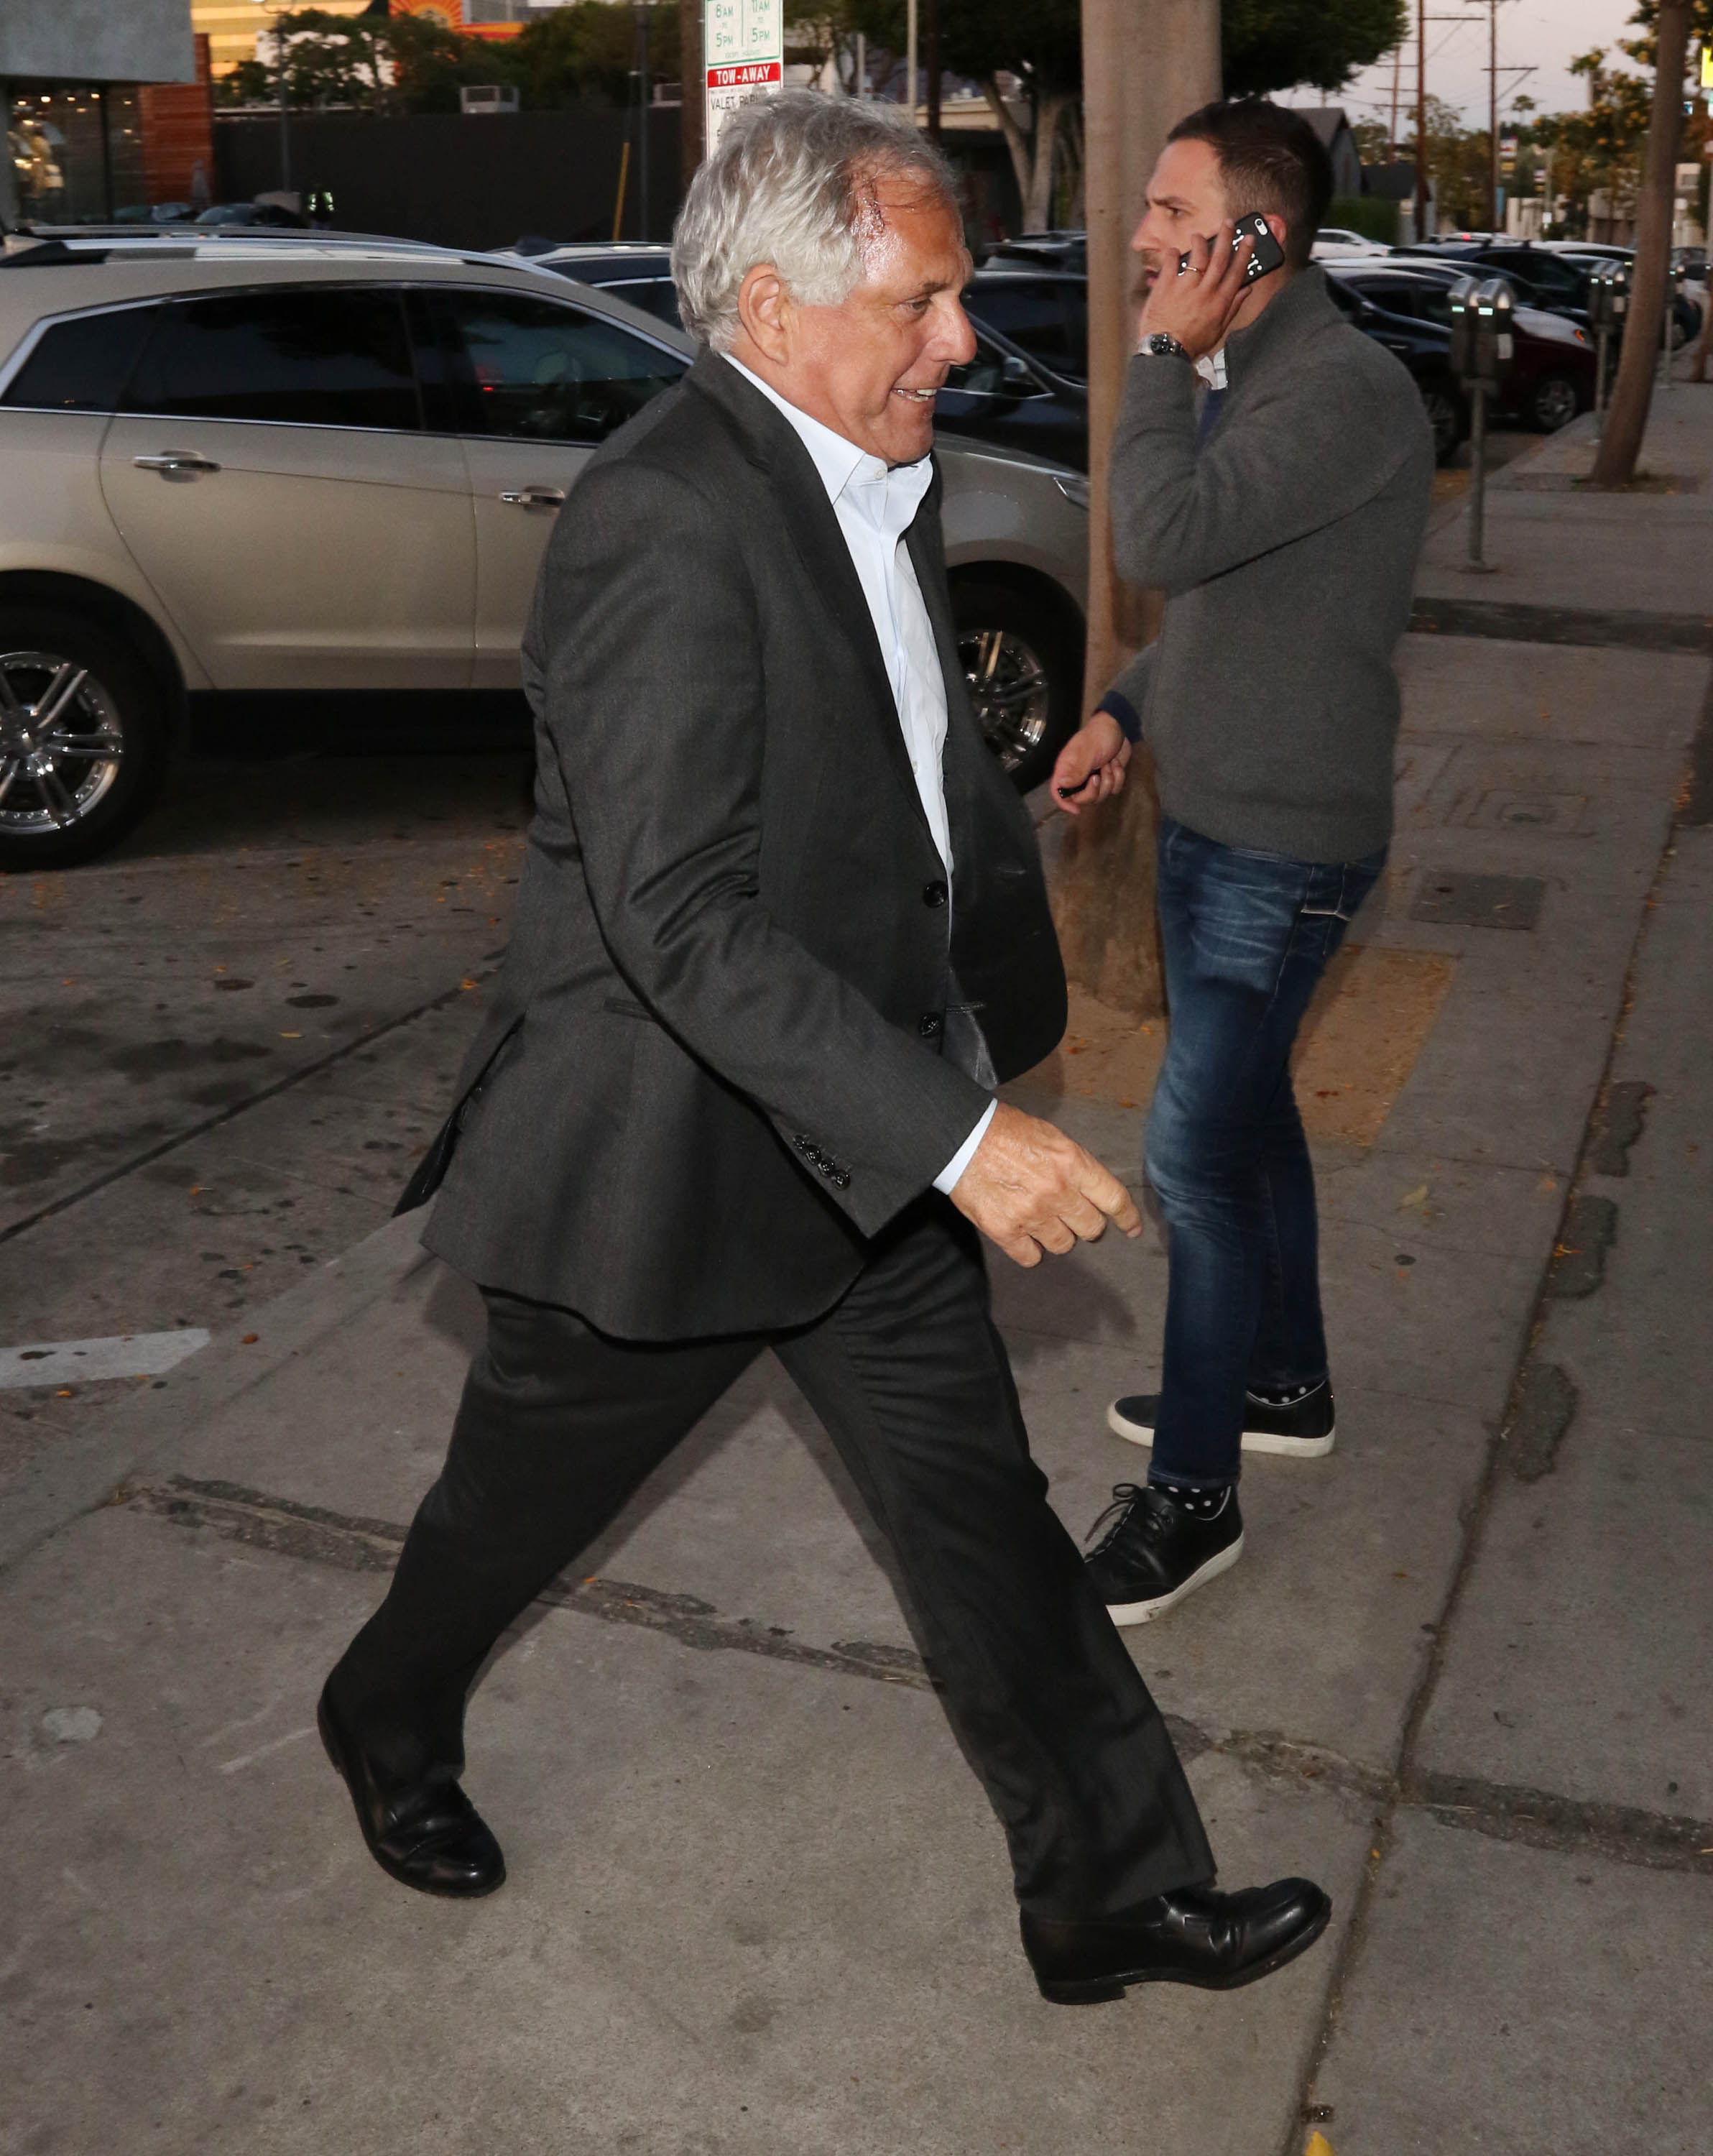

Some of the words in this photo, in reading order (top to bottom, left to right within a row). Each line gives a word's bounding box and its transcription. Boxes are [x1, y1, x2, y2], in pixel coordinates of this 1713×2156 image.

[716, 32, 733, 47] 5PM
[752, 28, 770, 42] 5PM
[716, 65, 771, 85] TOW-AWAY
[711, 96, 734, 109] VALET
